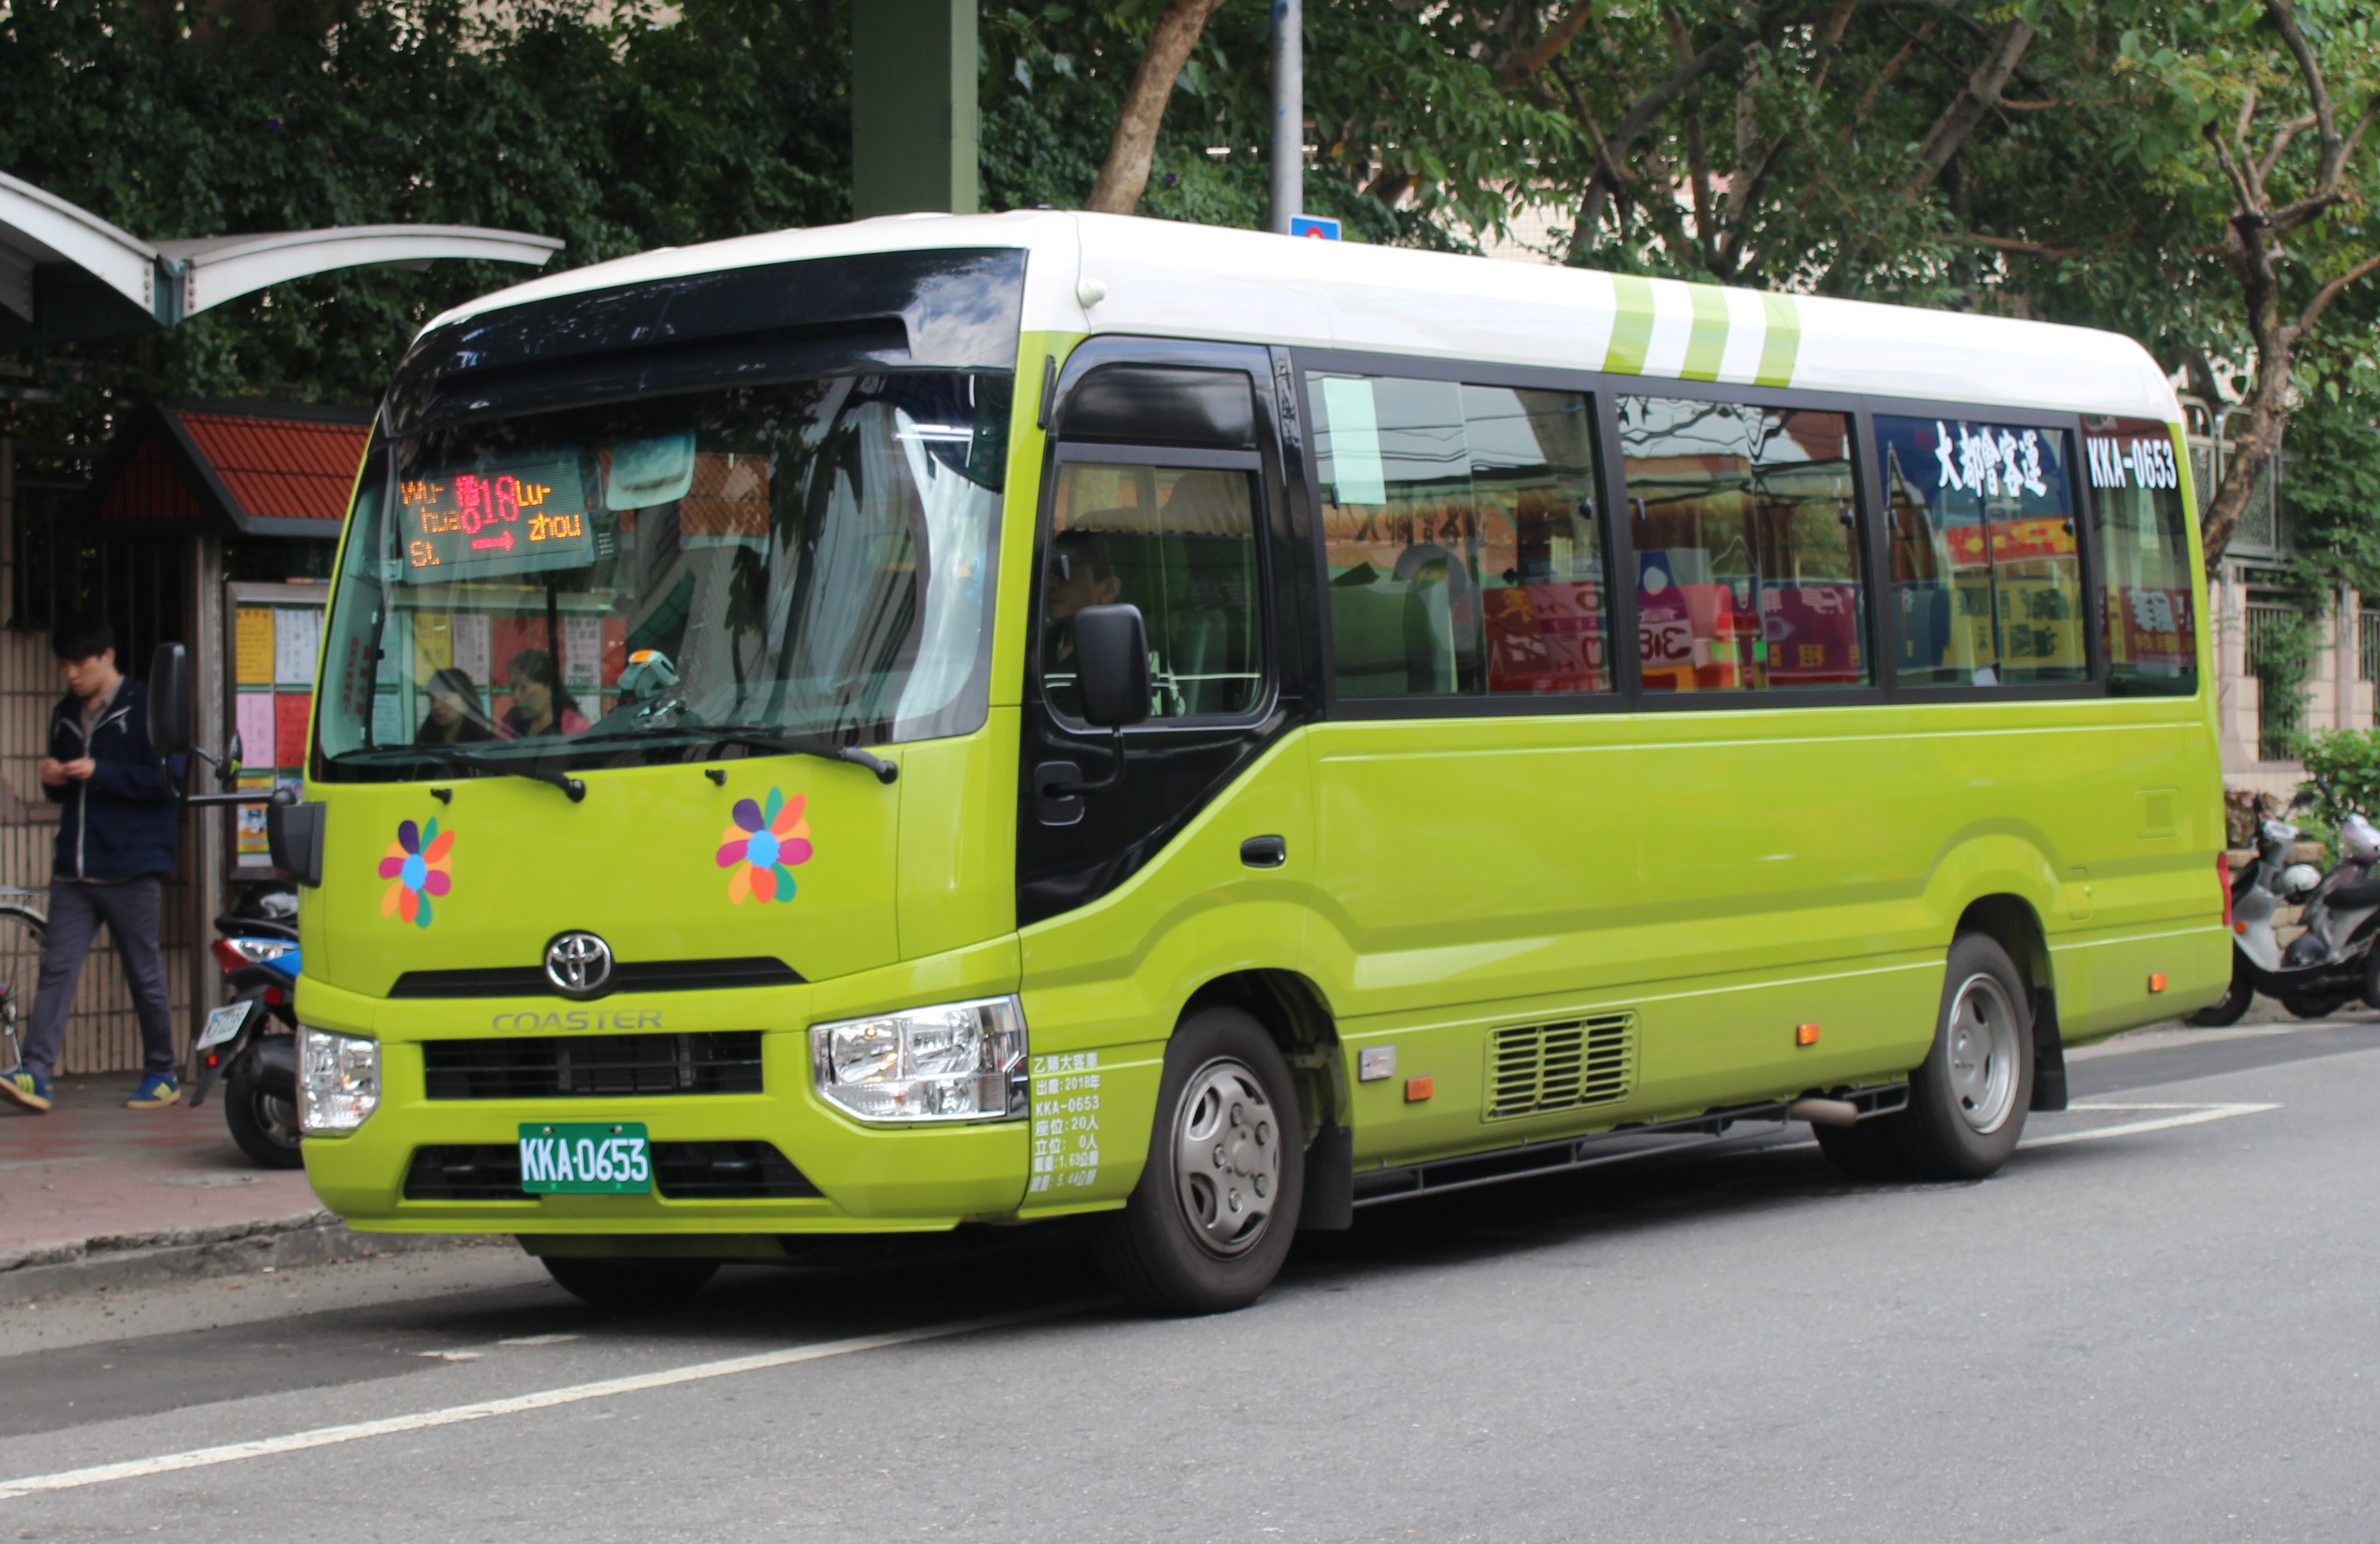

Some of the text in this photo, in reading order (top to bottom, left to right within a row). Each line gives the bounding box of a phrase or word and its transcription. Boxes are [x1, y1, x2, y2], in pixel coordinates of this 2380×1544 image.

[1934, 420, 2048, 498] 大都會客運
[2086, 437, 2178, 490] KKA-0653
[527, 512, 582, 542] zhou
[491, 1009, 663, 1034] COASTER
[1033, 1052, 1098, 1073] 乙類大客車
[1035, 1096, 1099, 1117] KKA-0653
